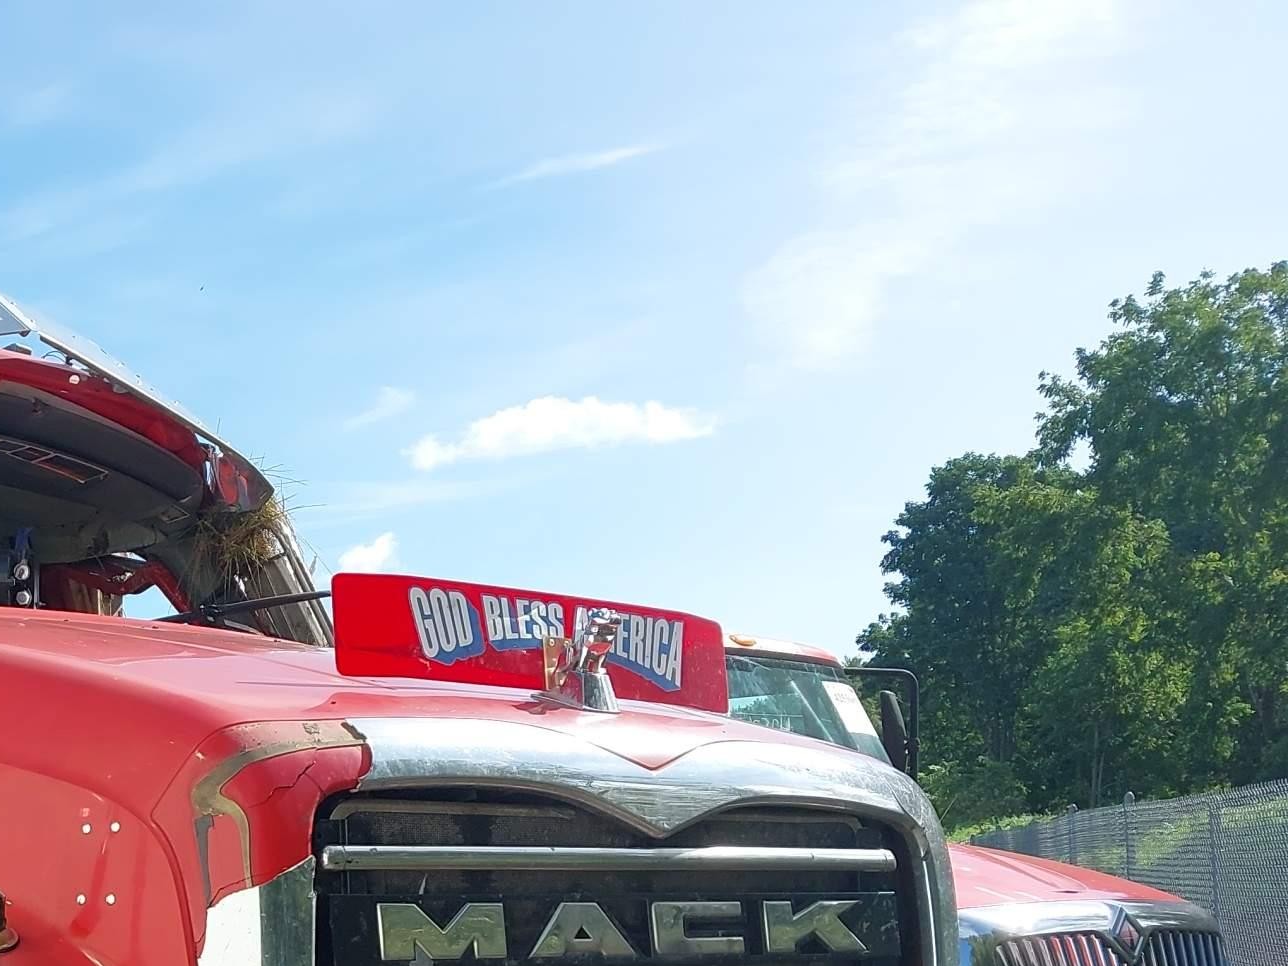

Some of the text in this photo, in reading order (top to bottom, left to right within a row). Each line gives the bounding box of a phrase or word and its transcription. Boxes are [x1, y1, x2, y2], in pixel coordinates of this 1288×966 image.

[408, 586, 685, 686] GOD BLESS AERICA
[376, 901, 870, 961] MACK
